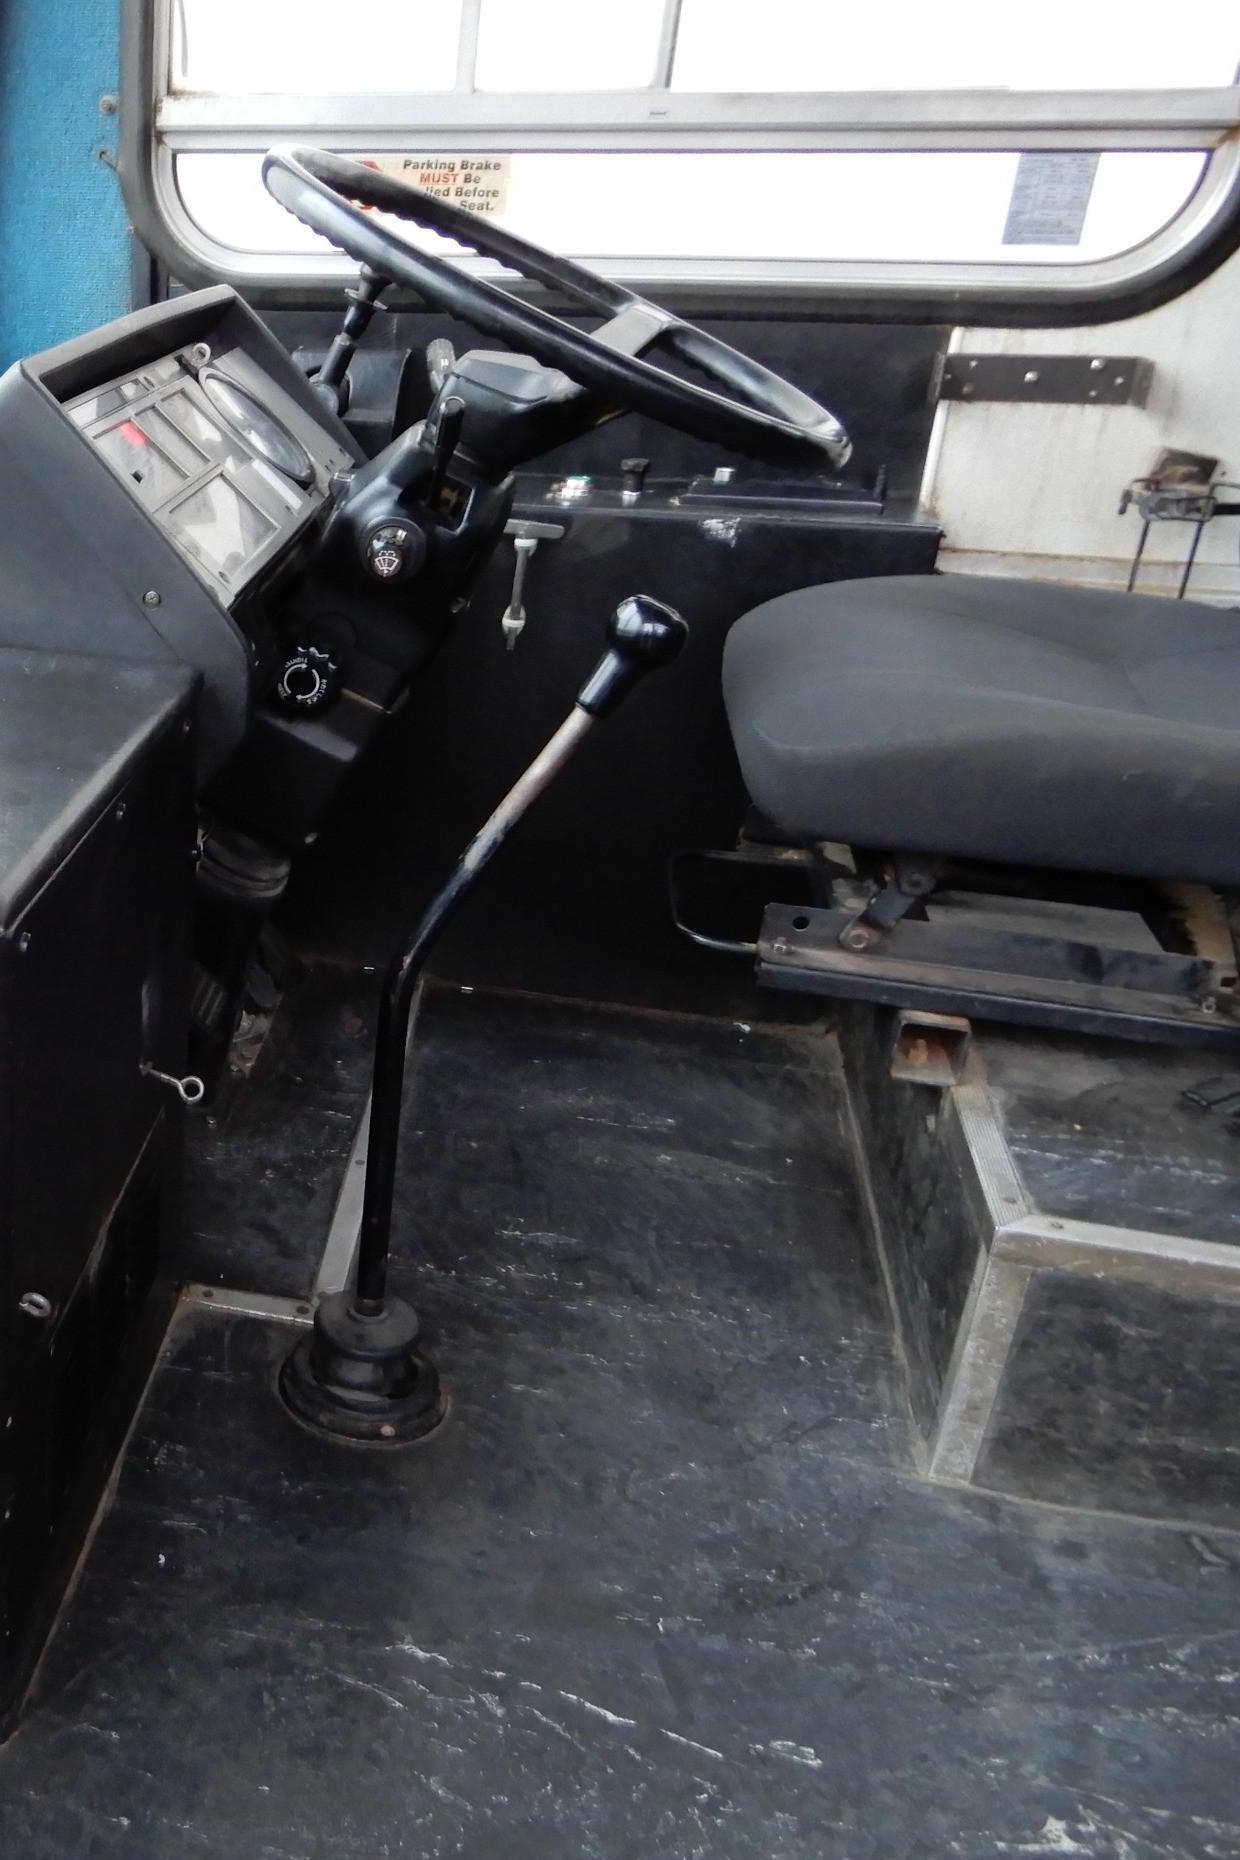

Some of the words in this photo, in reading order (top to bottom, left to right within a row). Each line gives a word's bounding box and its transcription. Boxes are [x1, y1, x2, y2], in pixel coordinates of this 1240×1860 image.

[403, 159, 455, 173] Parking
[460, 160, 501, 171] Brake
[419, 173, 458, 184] MUST
[464, 173, 480, 184] Be
[455, 187, 499, 198] Before
